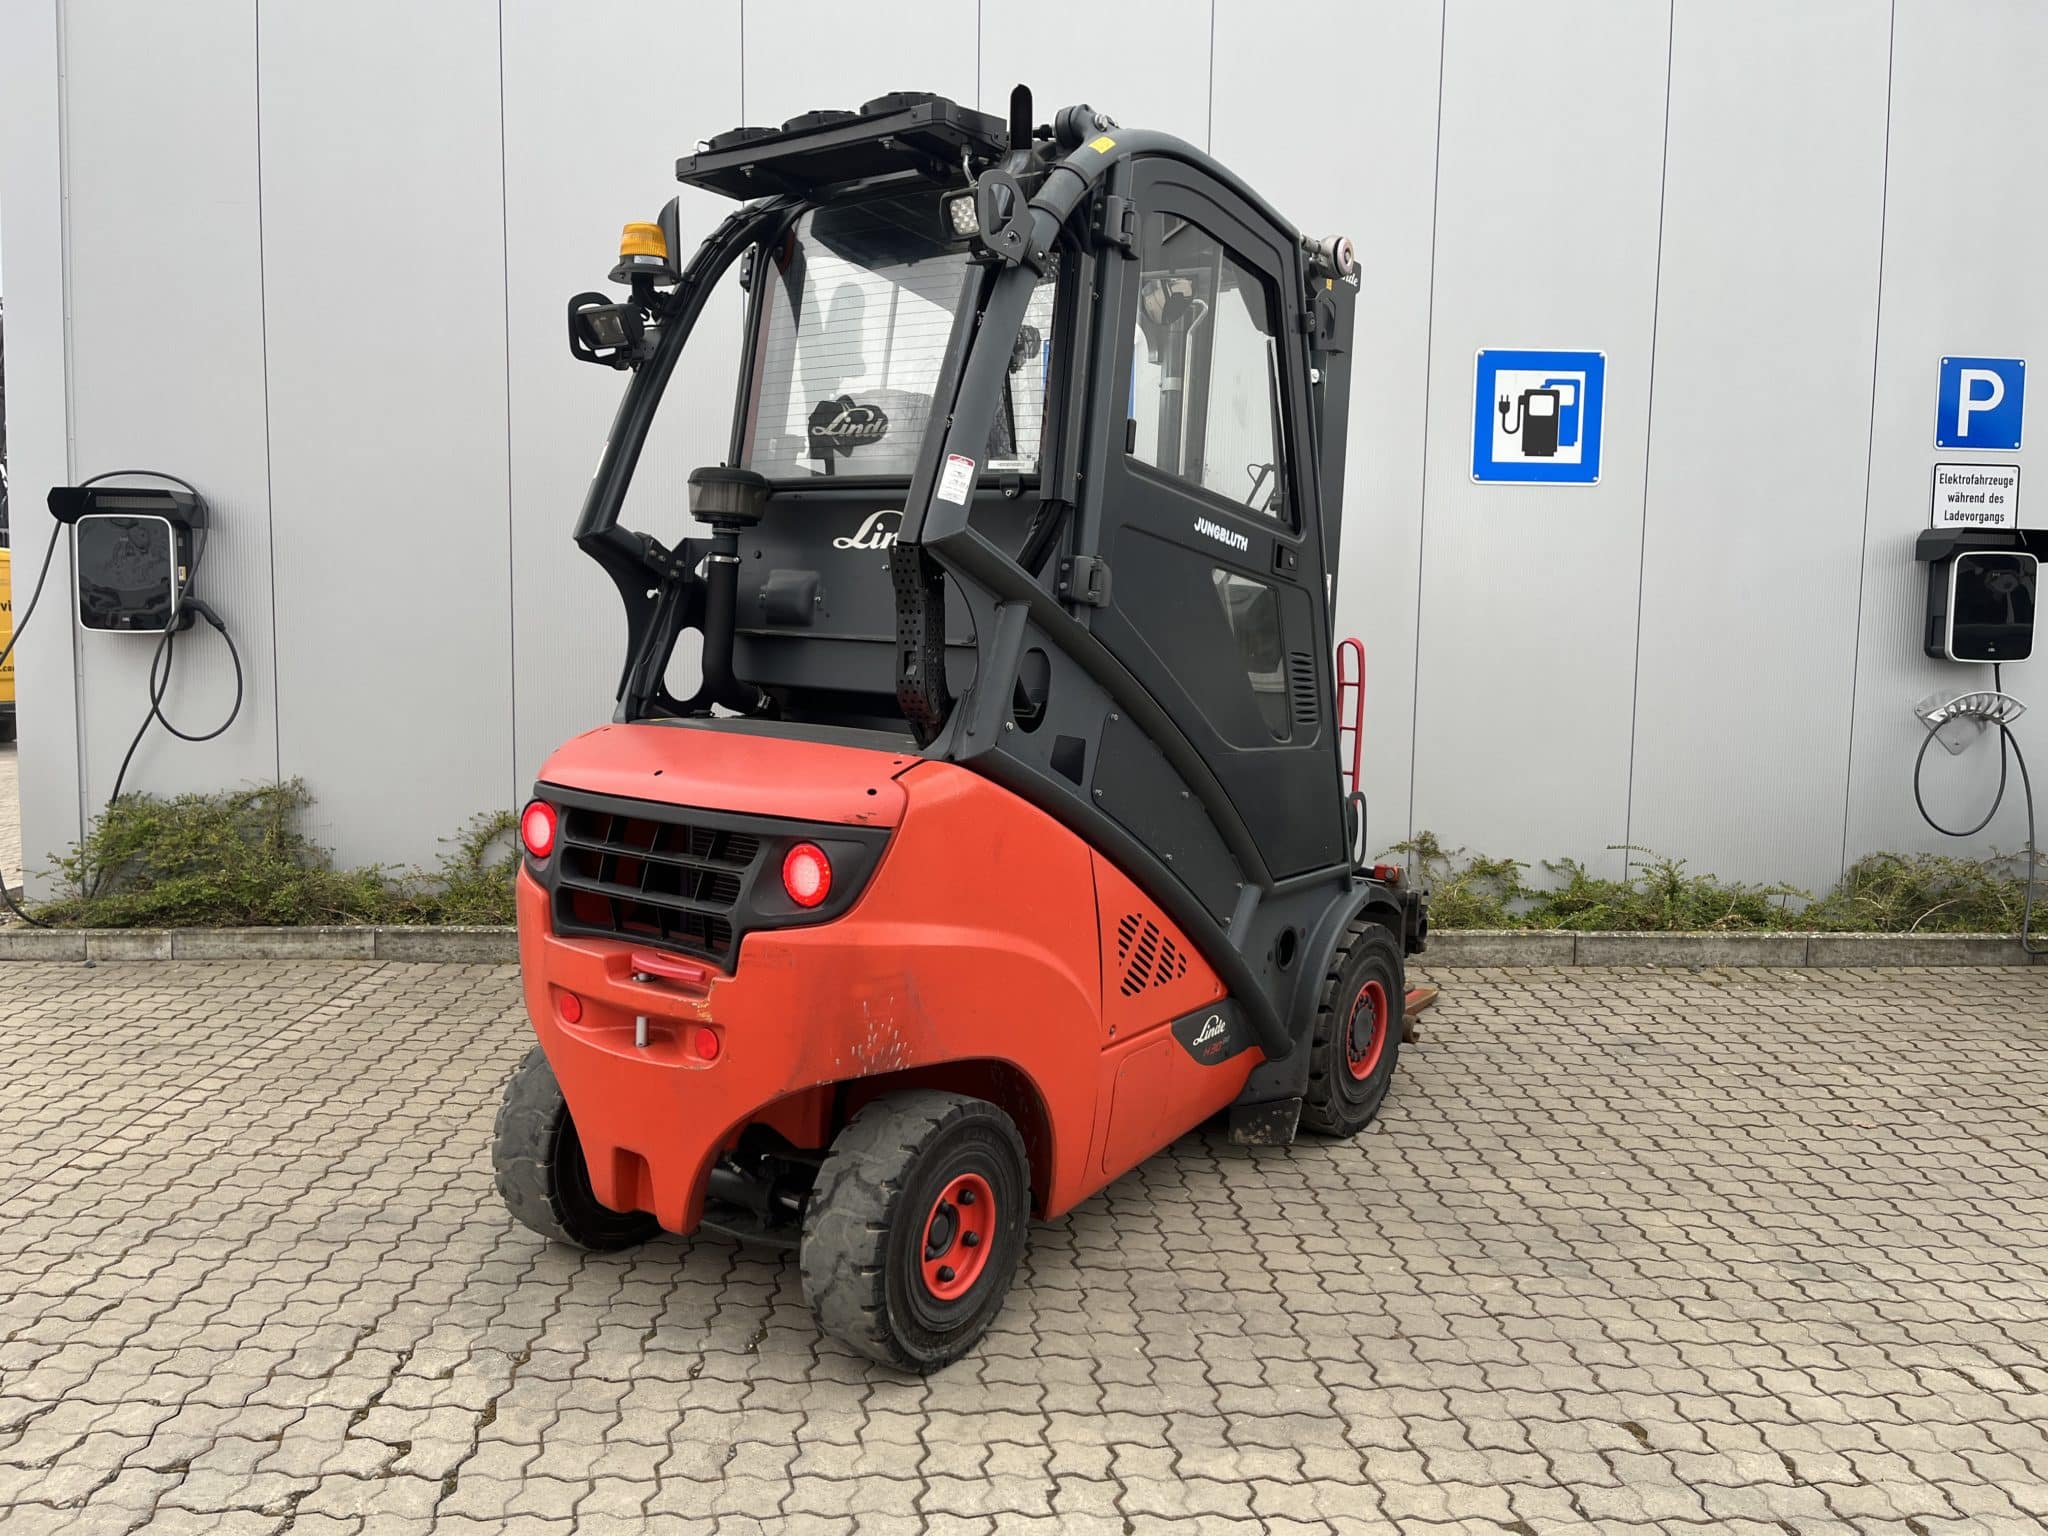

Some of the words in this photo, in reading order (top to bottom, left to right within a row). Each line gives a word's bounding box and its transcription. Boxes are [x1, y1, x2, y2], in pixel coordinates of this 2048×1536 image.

[1957, 368, 2005, 437] P
[1939, 473, 2014, 487] Elektrofahrzeuge
[1947, 492, 1985, 504] während
[1988, 493, 2004, 504] des
[832, 509, 904, 550] Lin
[1944, 510, 2005, 525] Ladevorgangs
[1194, 516, 1249, 552] JUNGBLUTH
[1192, 1014, 1226, 1046] Linde
